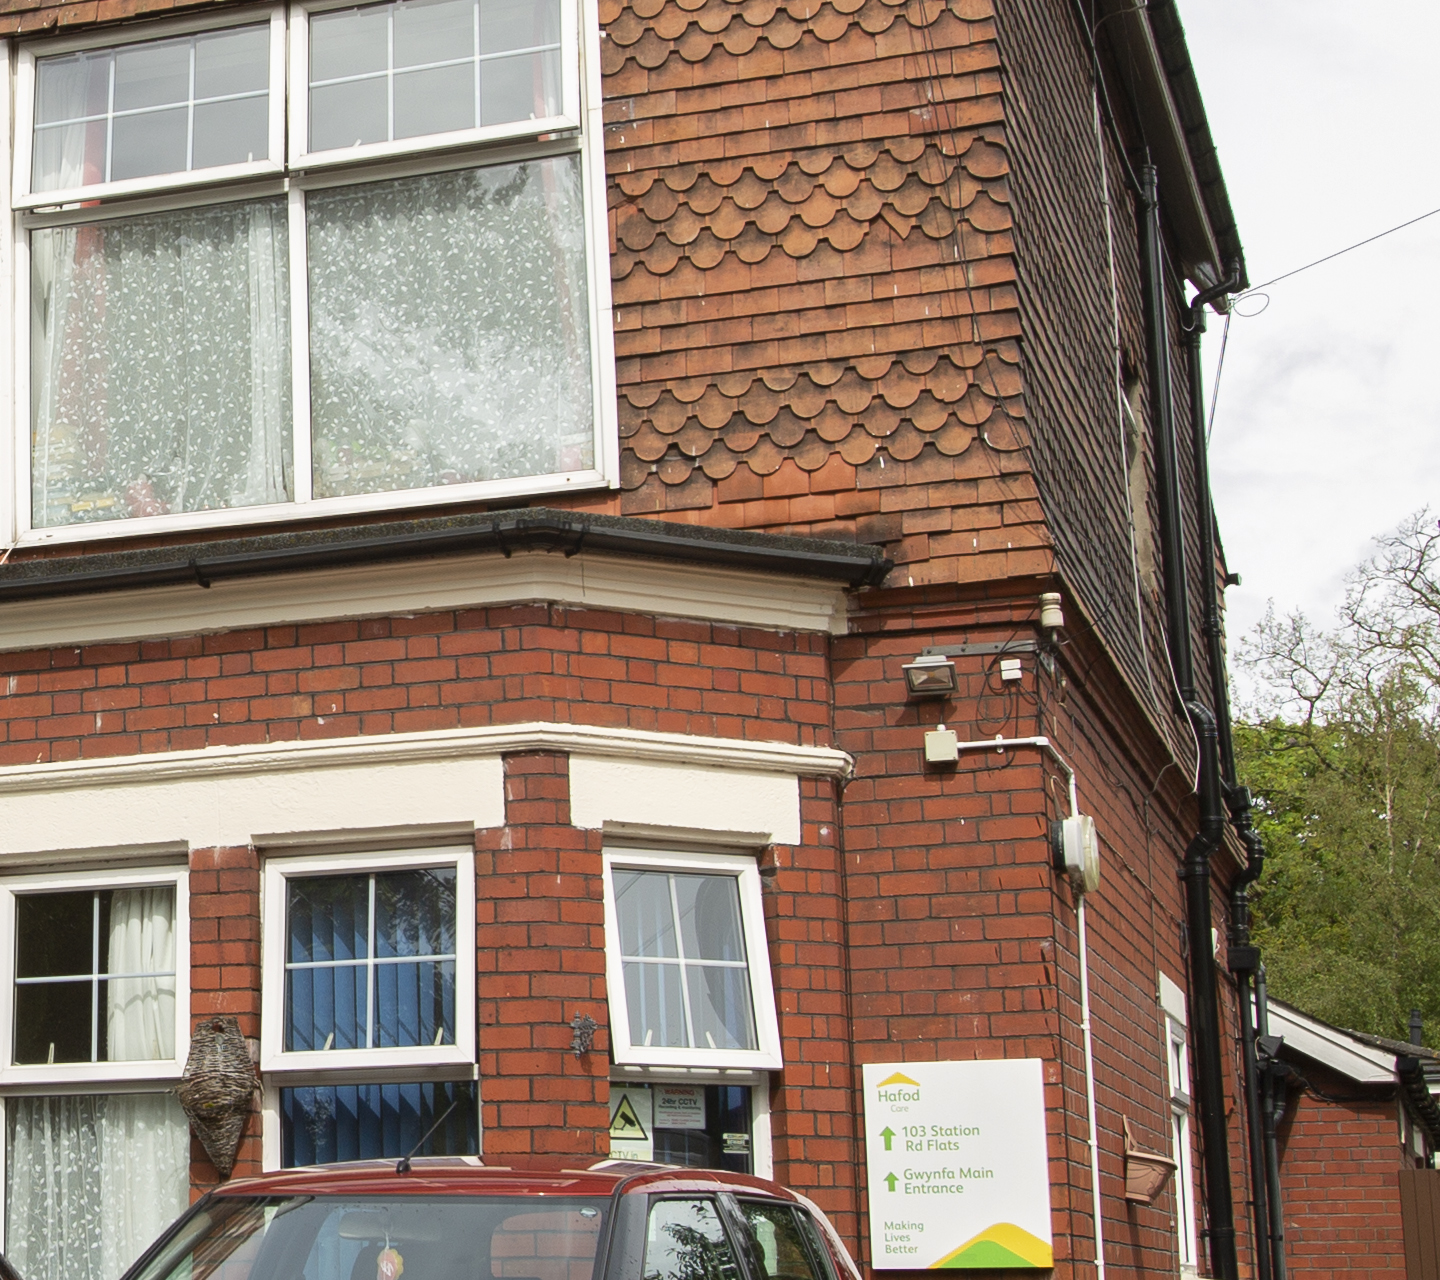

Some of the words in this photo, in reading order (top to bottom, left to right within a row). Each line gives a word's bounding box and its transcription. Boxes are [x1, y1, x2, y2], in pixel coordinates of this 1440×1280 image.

[878, 1088, 920, 1102] Hafod
[678, 1098, 697, 1106] CCTV
[890, 1104, 909, 1113] Care
[902, 1125, 927, 1138] 103
[931, 1125, 980, 1137] Station
[906, 1139, 923, 1152] Rd
[927, 1139, 960, 1151] Flats
[903, 1167, 955, 1183] Gwynfa
[959, 1167, 994, 1179] Main
[904, 1183, 964, 1195] Entrance
[884, 1220, 924, 1233] Making
[884, 1233, 911, 1242] Lives
[885, 1244, 918, 1254] Better
